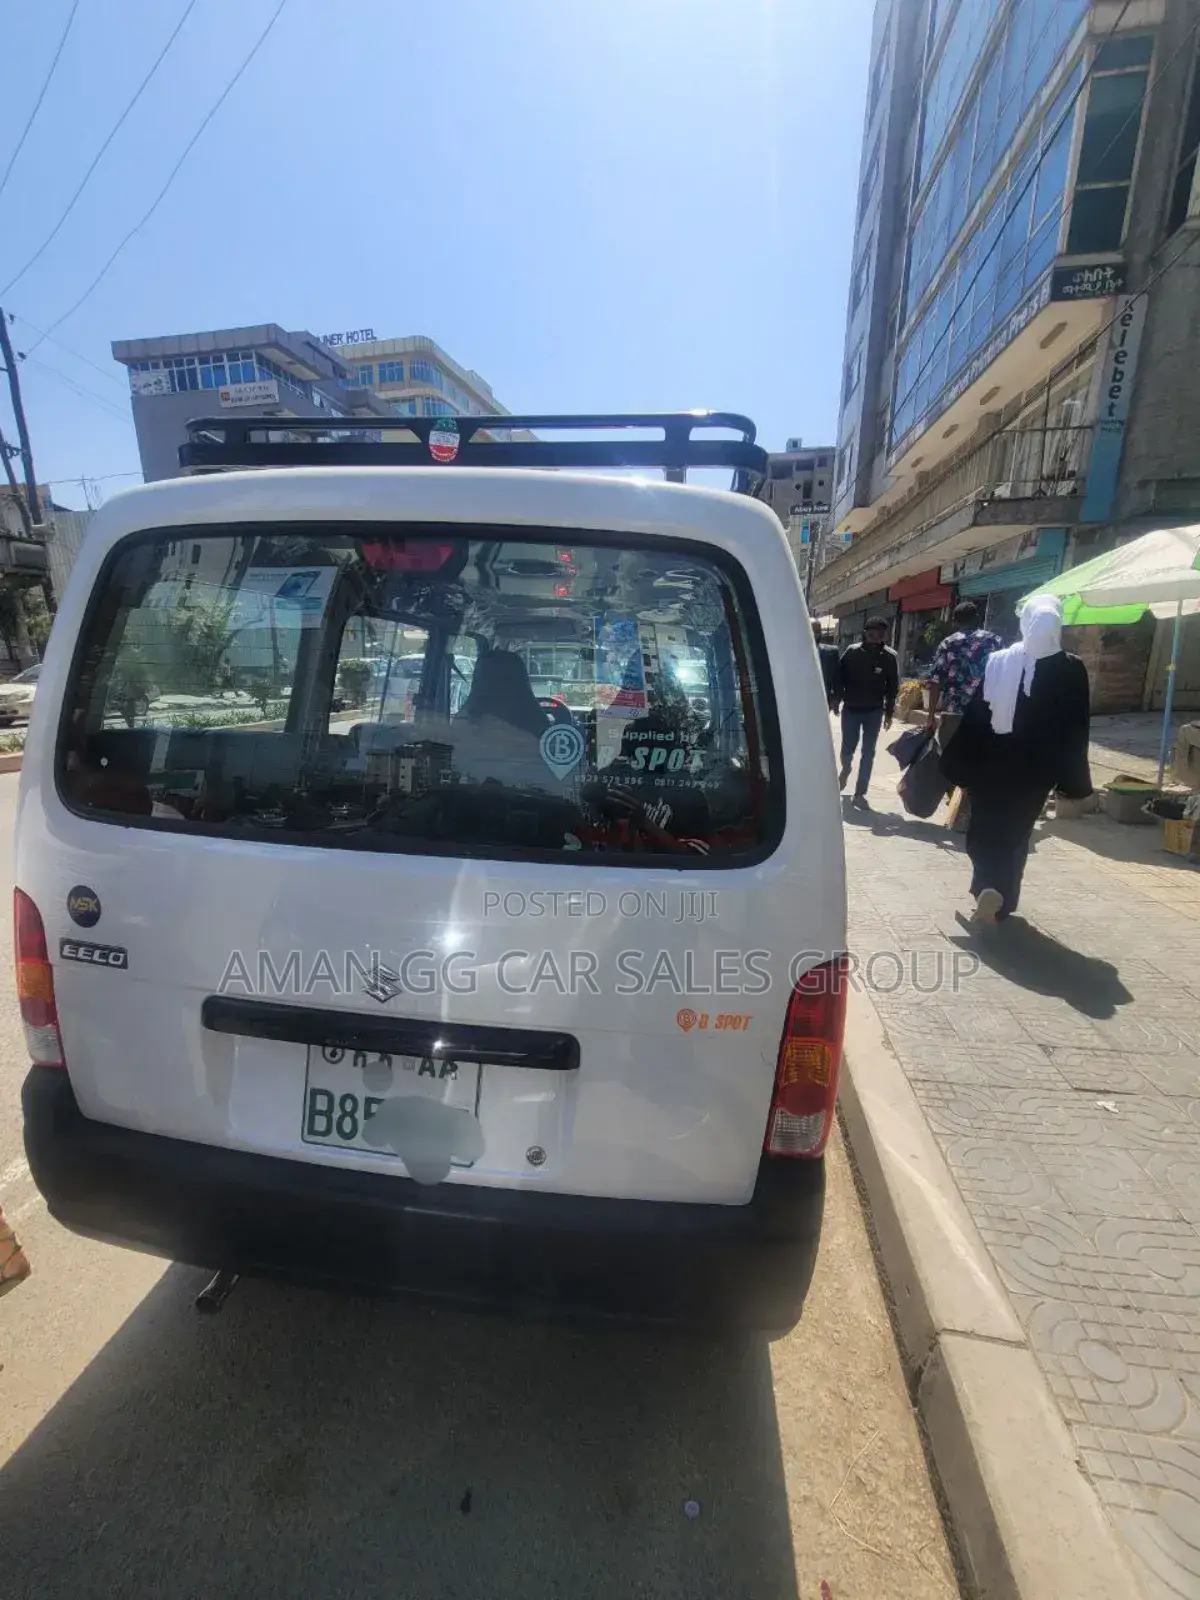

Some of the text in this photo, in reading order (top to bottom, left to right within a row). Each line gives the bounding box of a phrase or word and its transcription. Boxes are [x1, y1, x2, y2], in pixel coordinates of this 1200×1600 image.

[345, 328, 377, 345] HOTEL
[608, 730, 675, 741] Supplied
[62, 944, 126, 966] EECO
[714, 1013, 754, 1031] SPOT
